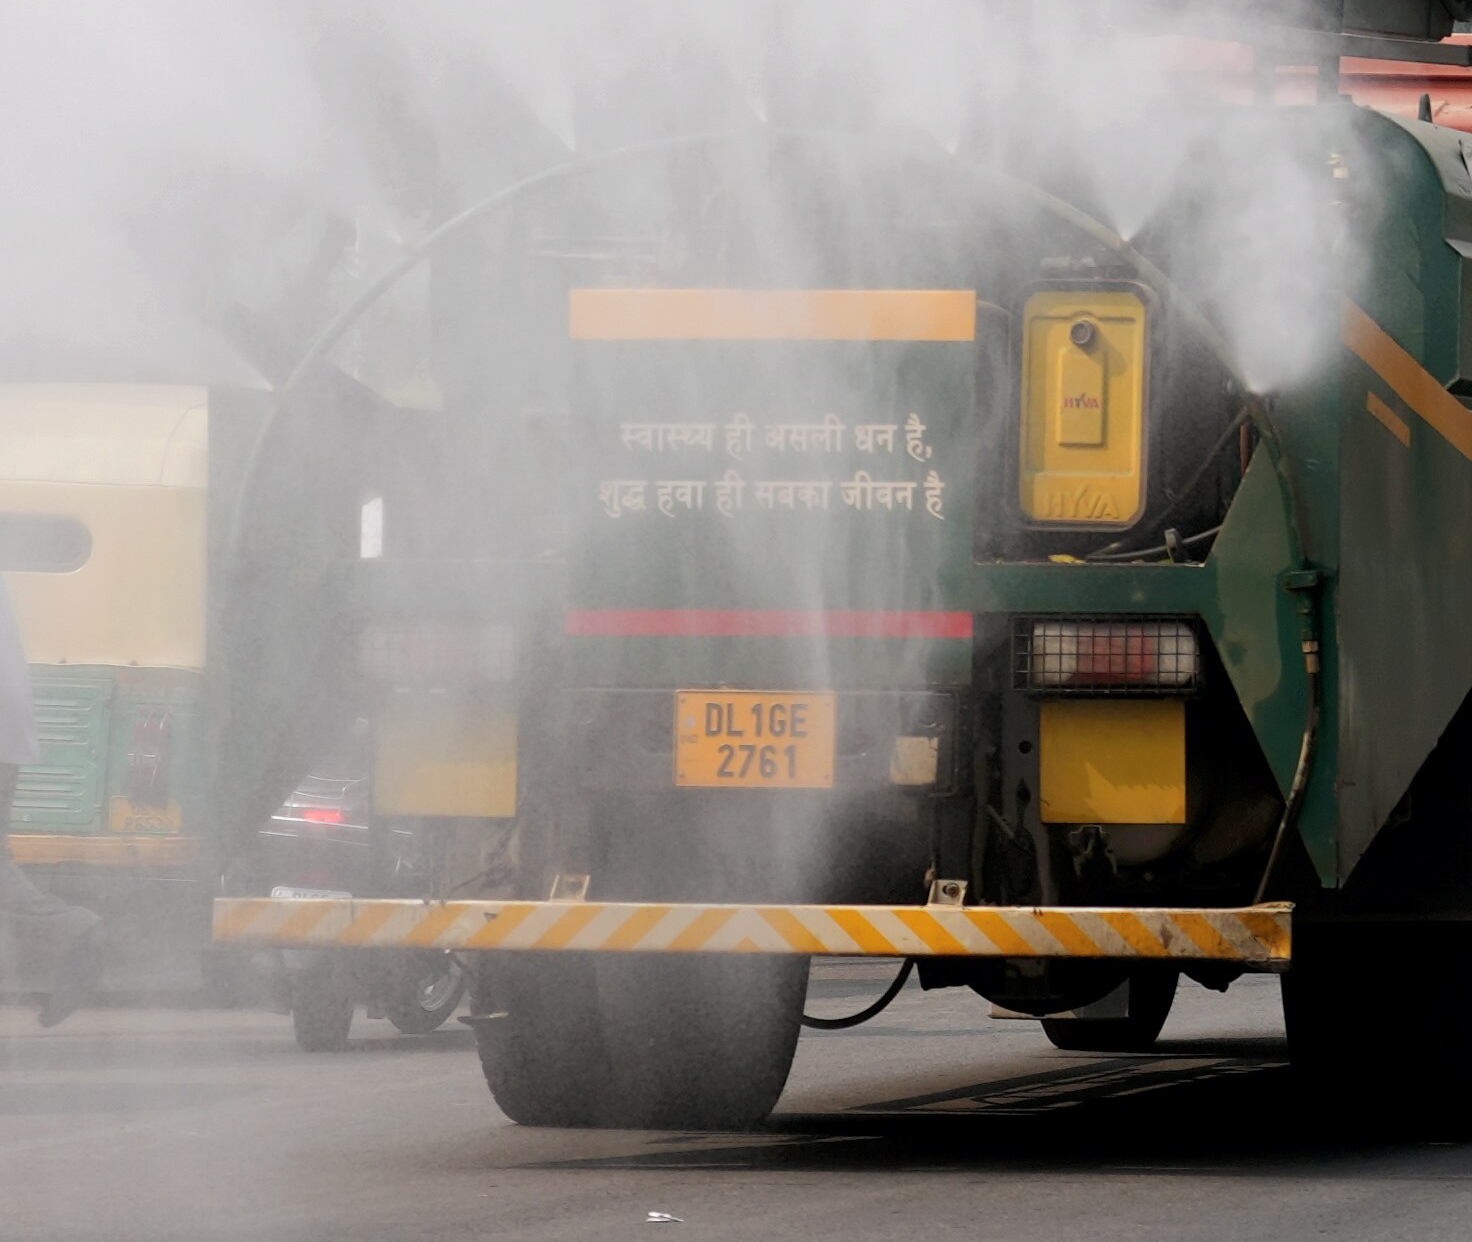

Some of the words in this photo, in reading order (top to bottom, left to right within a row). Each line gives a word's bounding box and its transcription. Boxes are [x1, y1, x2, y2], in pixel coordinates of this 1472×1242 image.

[1064, 392, 1099, 408] HYVA
[621, 421, 717, 453] स्वास्थ्य
[723, 412, 756, 461] ही
[764, 413, 846, 454] असली
[854, 422, 898, 454] धन
[598, 479, 647, 519] शुद्ध
[654, 480, 707, 518] हवा
[712, 469, 746, 518] ही
[753, 480, 833, 510] सबका
[840, 470, 918, 512] जीवन
[923, 469, 946, 520] है
[716, 744, 797, 779] 2761
